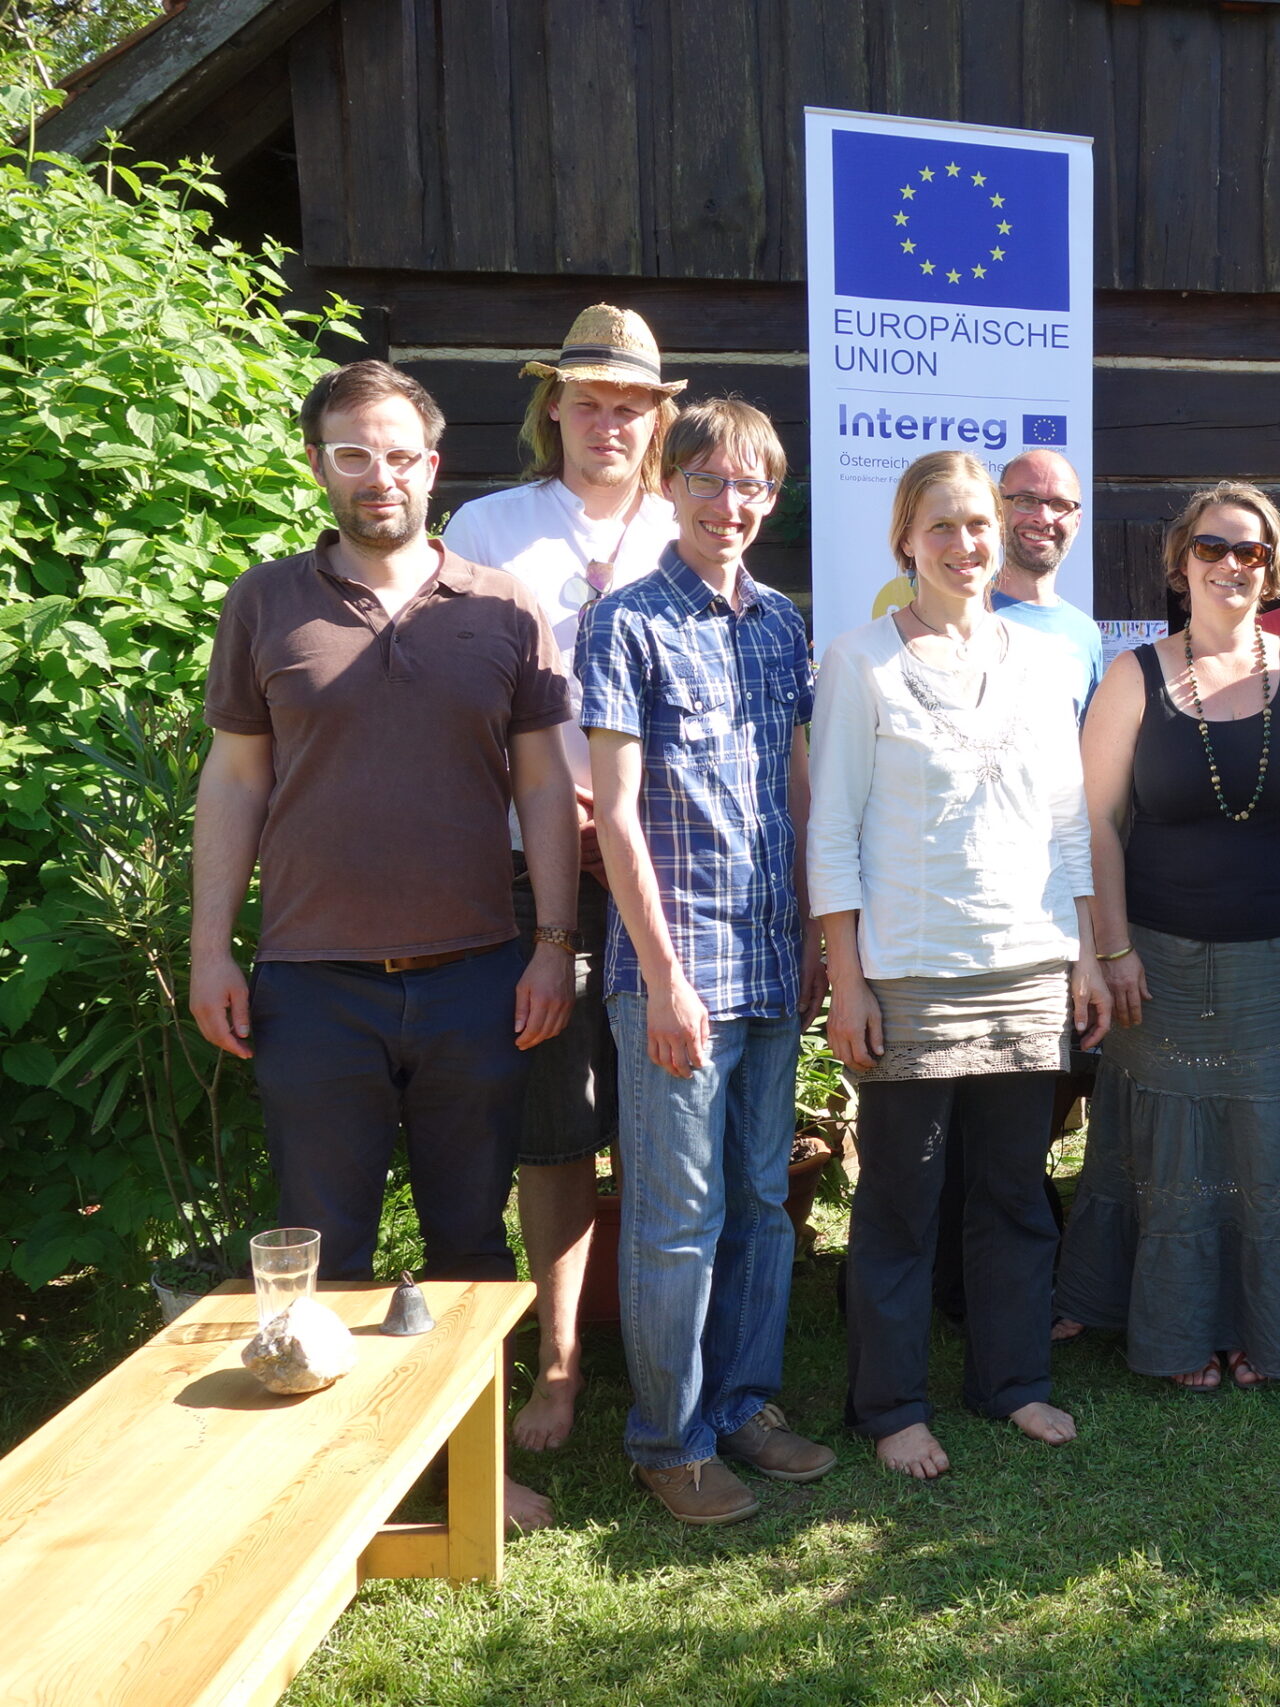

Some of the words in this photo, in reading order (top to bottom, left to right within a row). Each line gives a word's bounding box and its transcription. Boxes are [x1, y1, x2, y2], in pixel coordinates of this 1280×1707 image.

[834, 309, 1070, 349] EUROPÄISCHE
[834, 345, 938, 376] UNION
[839, 404, 1008, 450] Interreg
[840, 451, 910, 469] Österreich
